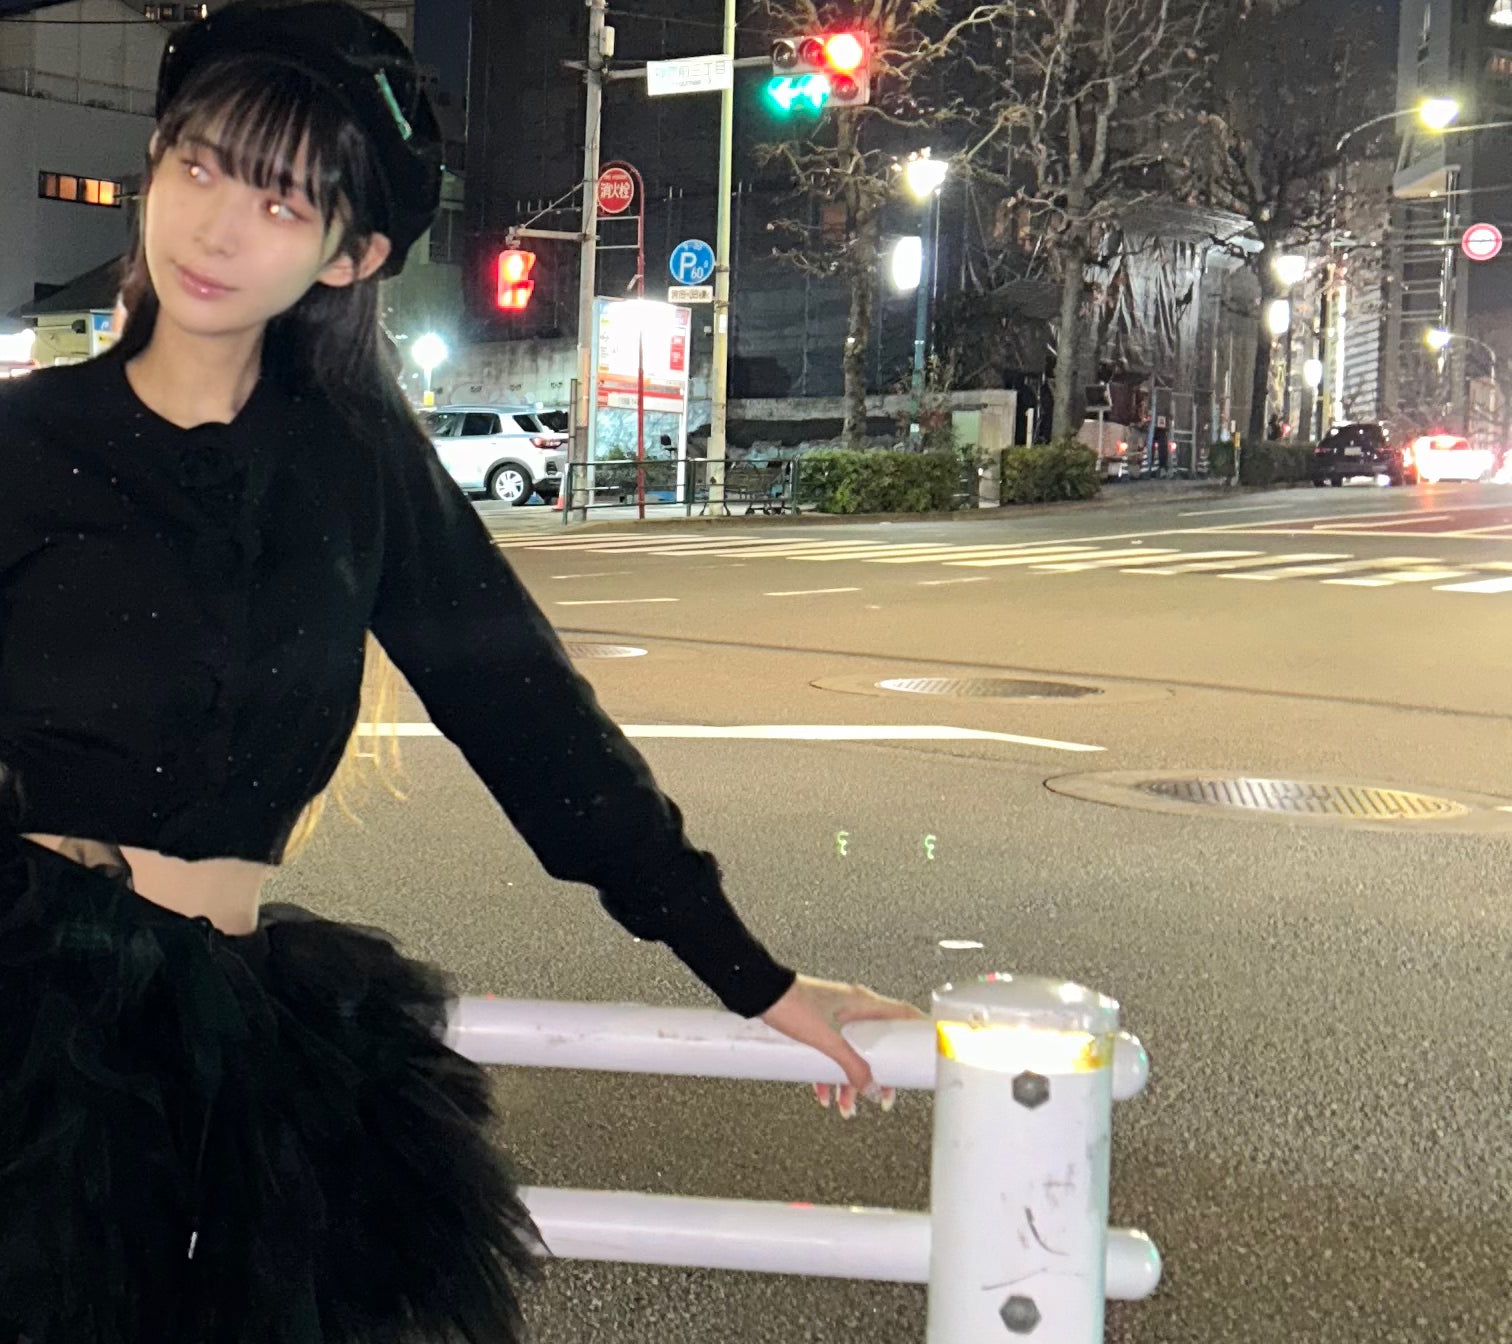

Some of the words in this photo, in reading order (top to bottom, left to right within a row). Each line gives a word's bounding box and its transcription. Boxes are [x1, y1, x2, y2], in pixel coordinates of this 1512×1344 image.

[655, 60, 726, 78] 前三丁目
[600, 182, 631, 199] 消火栓
[679, 251, 697, 280] P
